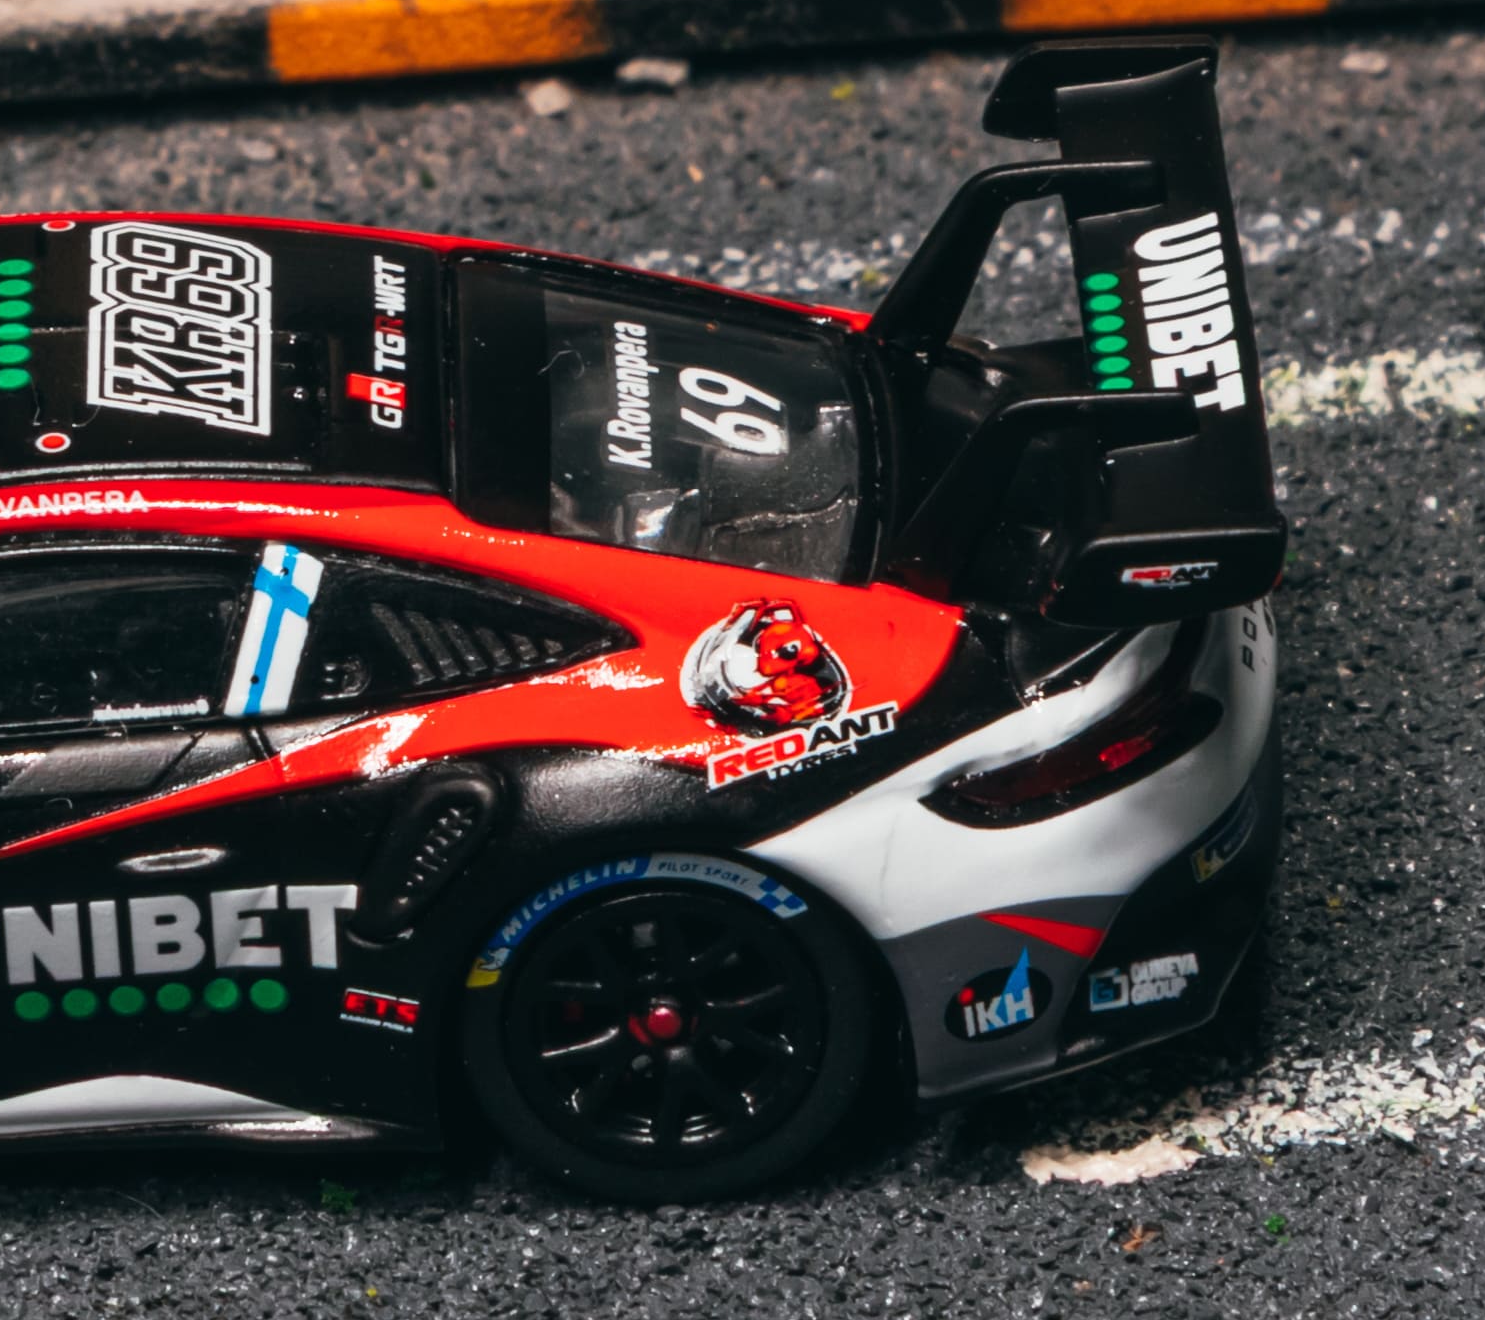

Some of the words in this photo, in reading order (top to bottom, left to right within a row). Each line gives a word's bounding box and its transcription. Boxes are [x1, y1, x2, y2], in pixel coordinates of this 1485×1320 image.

[1134, 212, 1246, 411] UNIBET
[370, 381, 405, 429] GR
[607, 321, 660, 469] K.Rovanpera
[679, 367, 782, 455] 69
[771, 743, 858, 780] TYRES
[502, 858, 637, 942] MICHELIN
